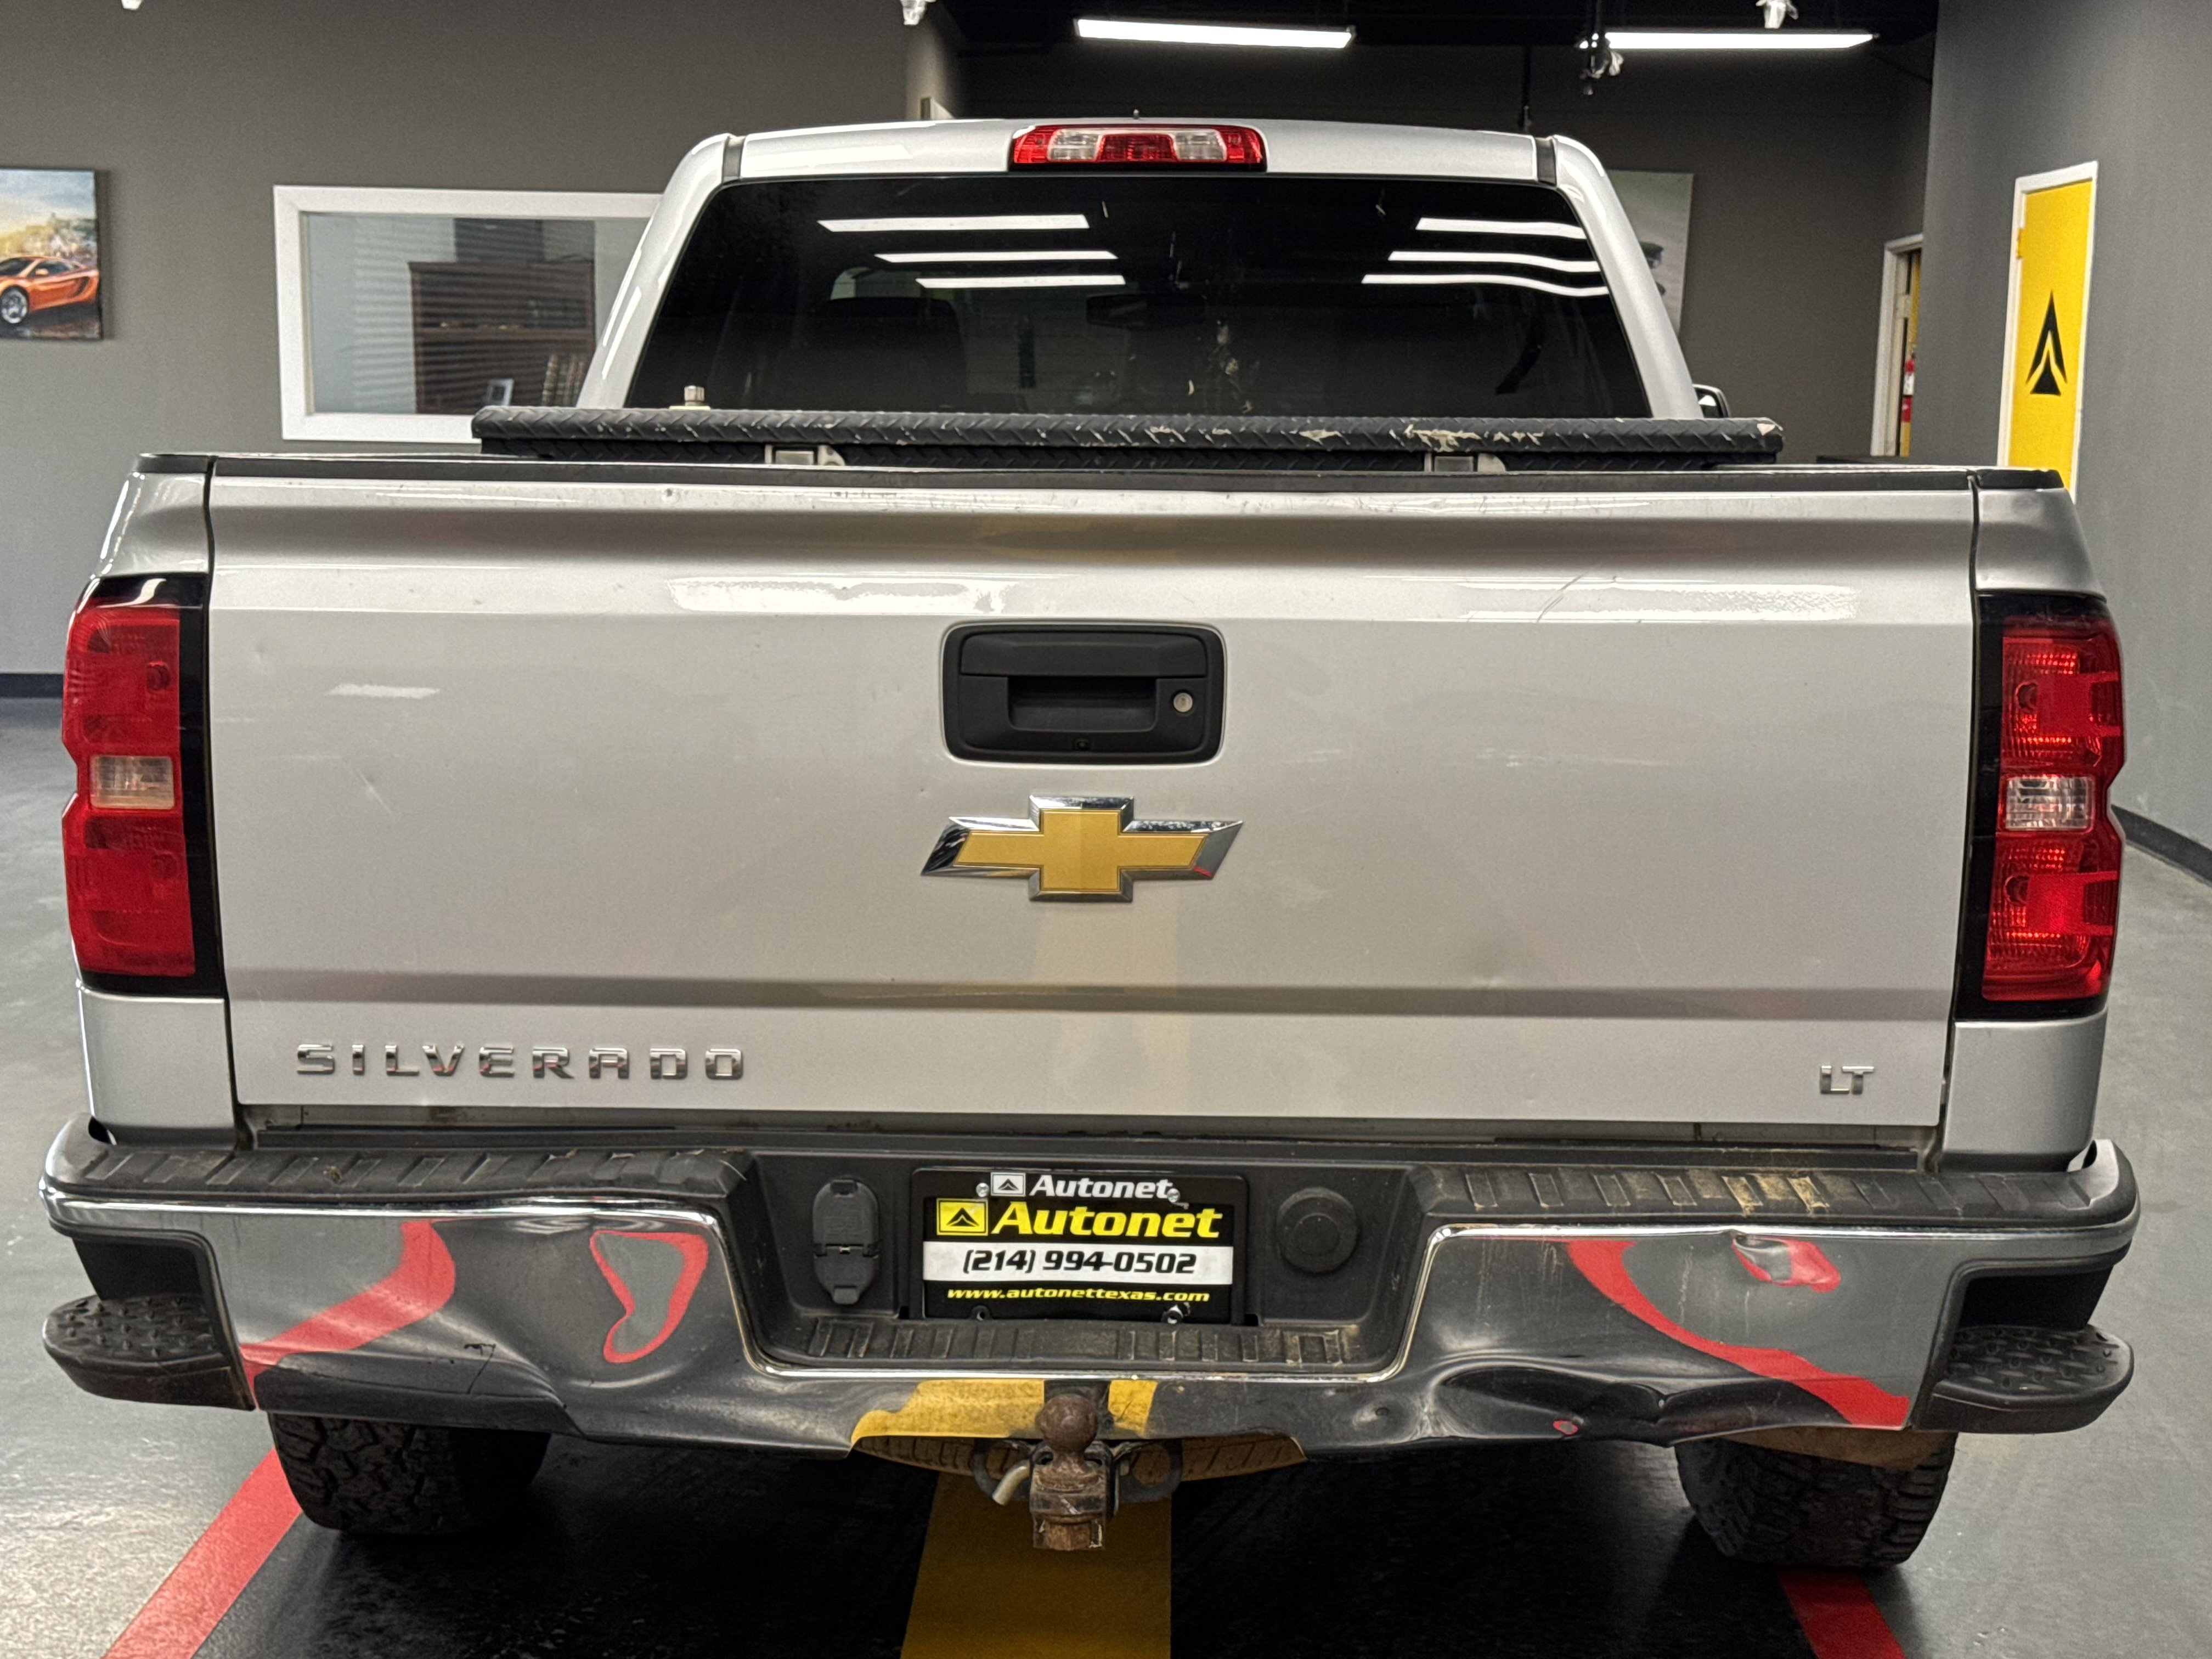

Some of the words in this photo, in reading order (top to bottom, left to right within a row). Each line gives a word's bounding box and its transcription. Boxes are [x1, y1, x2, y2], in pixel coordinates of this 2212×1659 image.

[296, 1043, 744, 1080] SILVERADO
[1820, 1065, 1875, 1094] LT
[1029, 1175, 1173, 1199] Autonet
[991, 1201, 1223, 1238] Autonet
[963, 1250, 1036, 1274] (214)
[1043, 1250, 1197, 1274] 994-0502
[947, 1288, 1210, 1301] www.autonettexas.com
